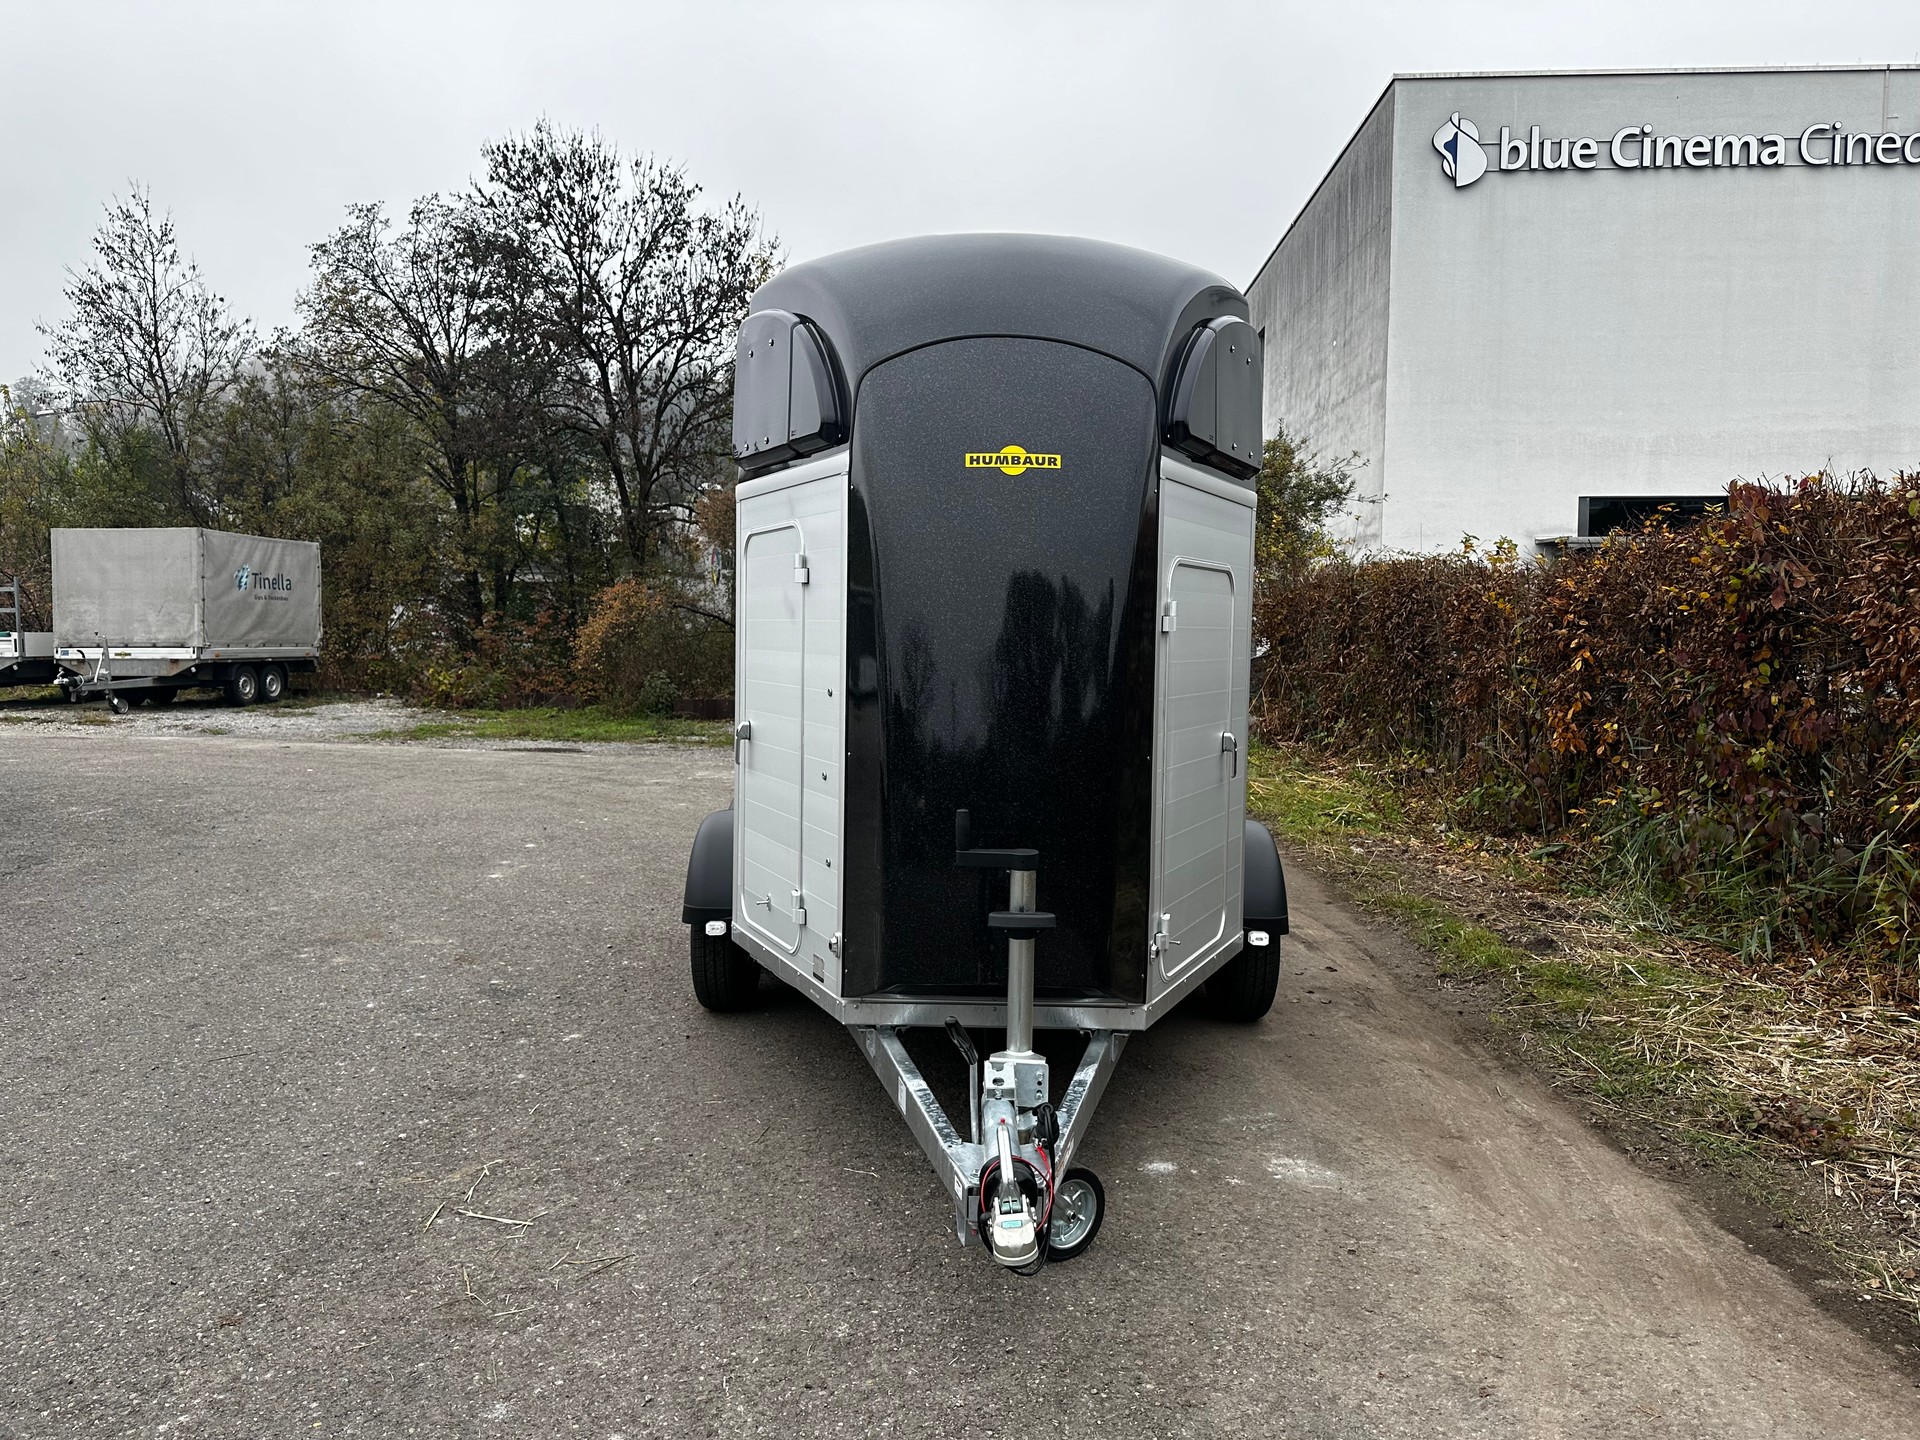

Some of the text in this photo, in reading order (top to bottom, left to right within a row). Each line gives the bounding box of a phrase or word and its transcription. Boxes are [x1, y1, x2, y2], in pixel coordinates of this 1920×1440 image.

[1499, 126, 1599, 171] blue
[1610, 123, 1786, 168] Cinema
[969, 455, 1058, 467] HUMBAUR
[251, 572, 292, 591] Tinella
